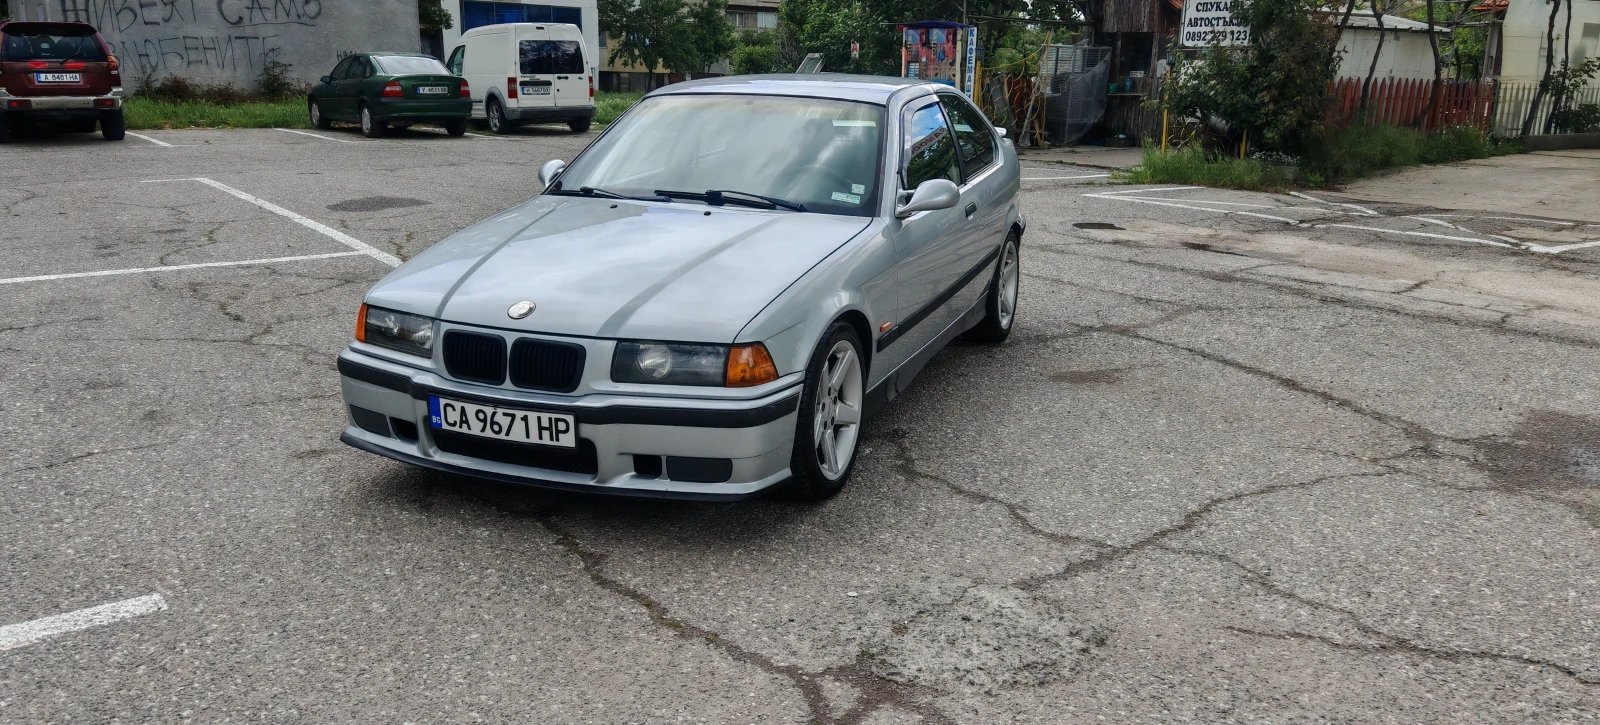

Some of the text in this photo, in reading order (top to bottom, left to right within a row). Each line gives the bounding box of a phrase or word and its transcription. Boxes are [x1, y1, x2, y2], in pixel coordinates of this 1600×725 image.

[1185, 31, 1207, 42] 0892
[1230, 30, 1248, 41] 123
[432, 415, 441, 424] BG
[443, 402, 570, 443] CA 9671 HP
